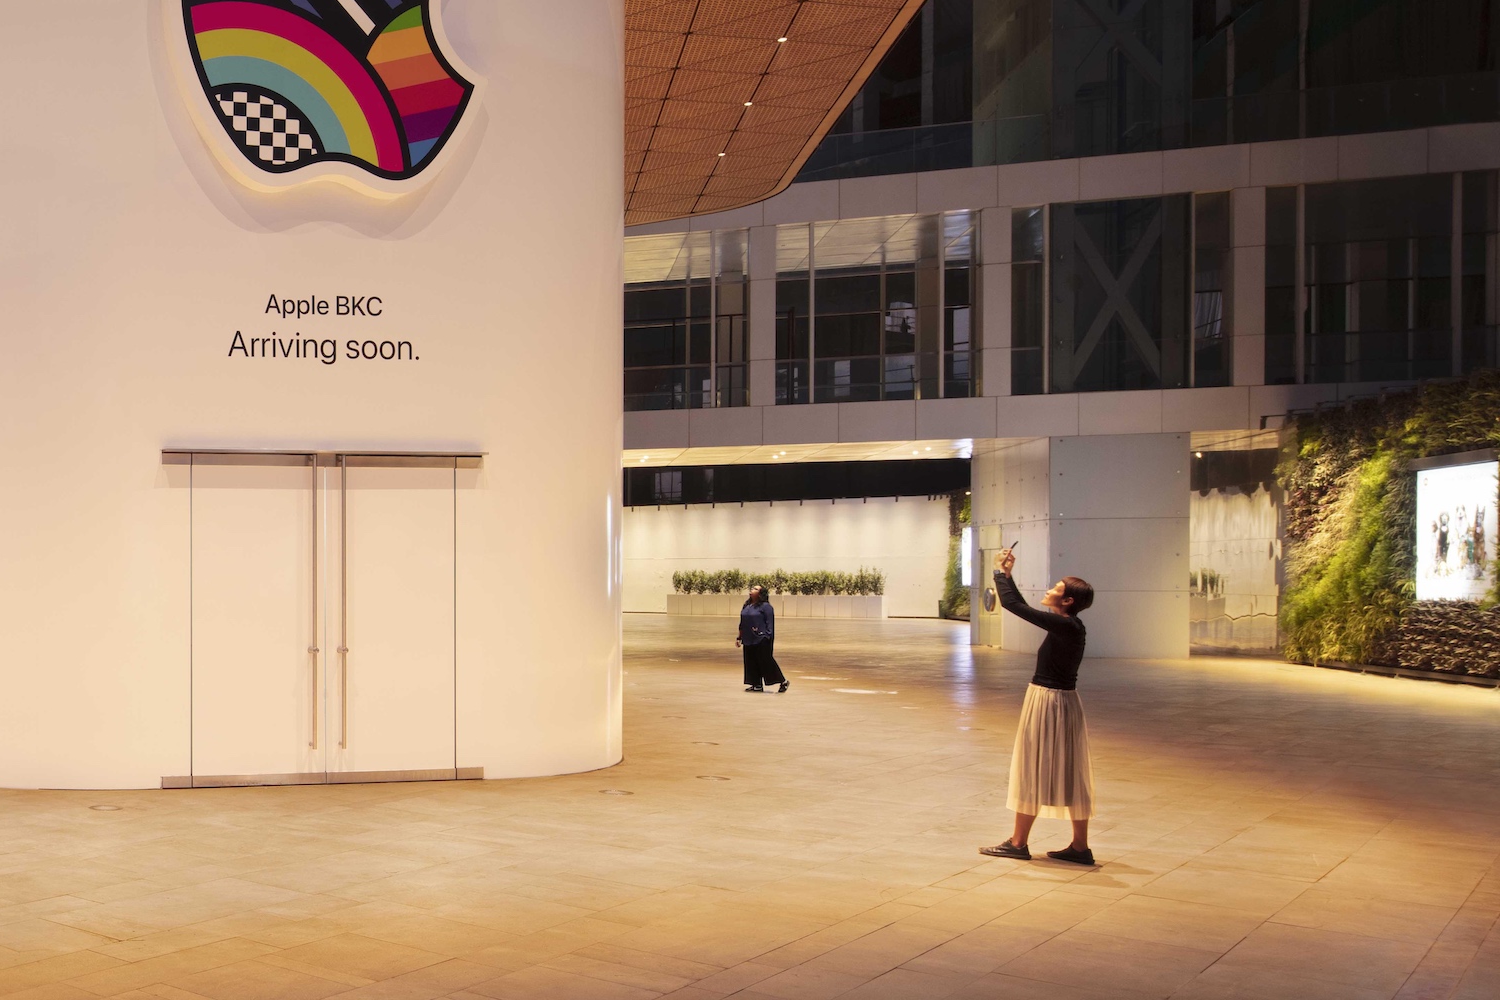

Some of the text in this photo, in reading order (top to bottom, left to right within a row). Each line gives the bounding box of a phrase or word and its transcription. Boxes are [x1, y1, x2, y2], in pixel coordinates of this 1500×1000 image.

[265, 294, 383, 319] Apple BKC
[228, 330, 420, 365] Arriving soon.
